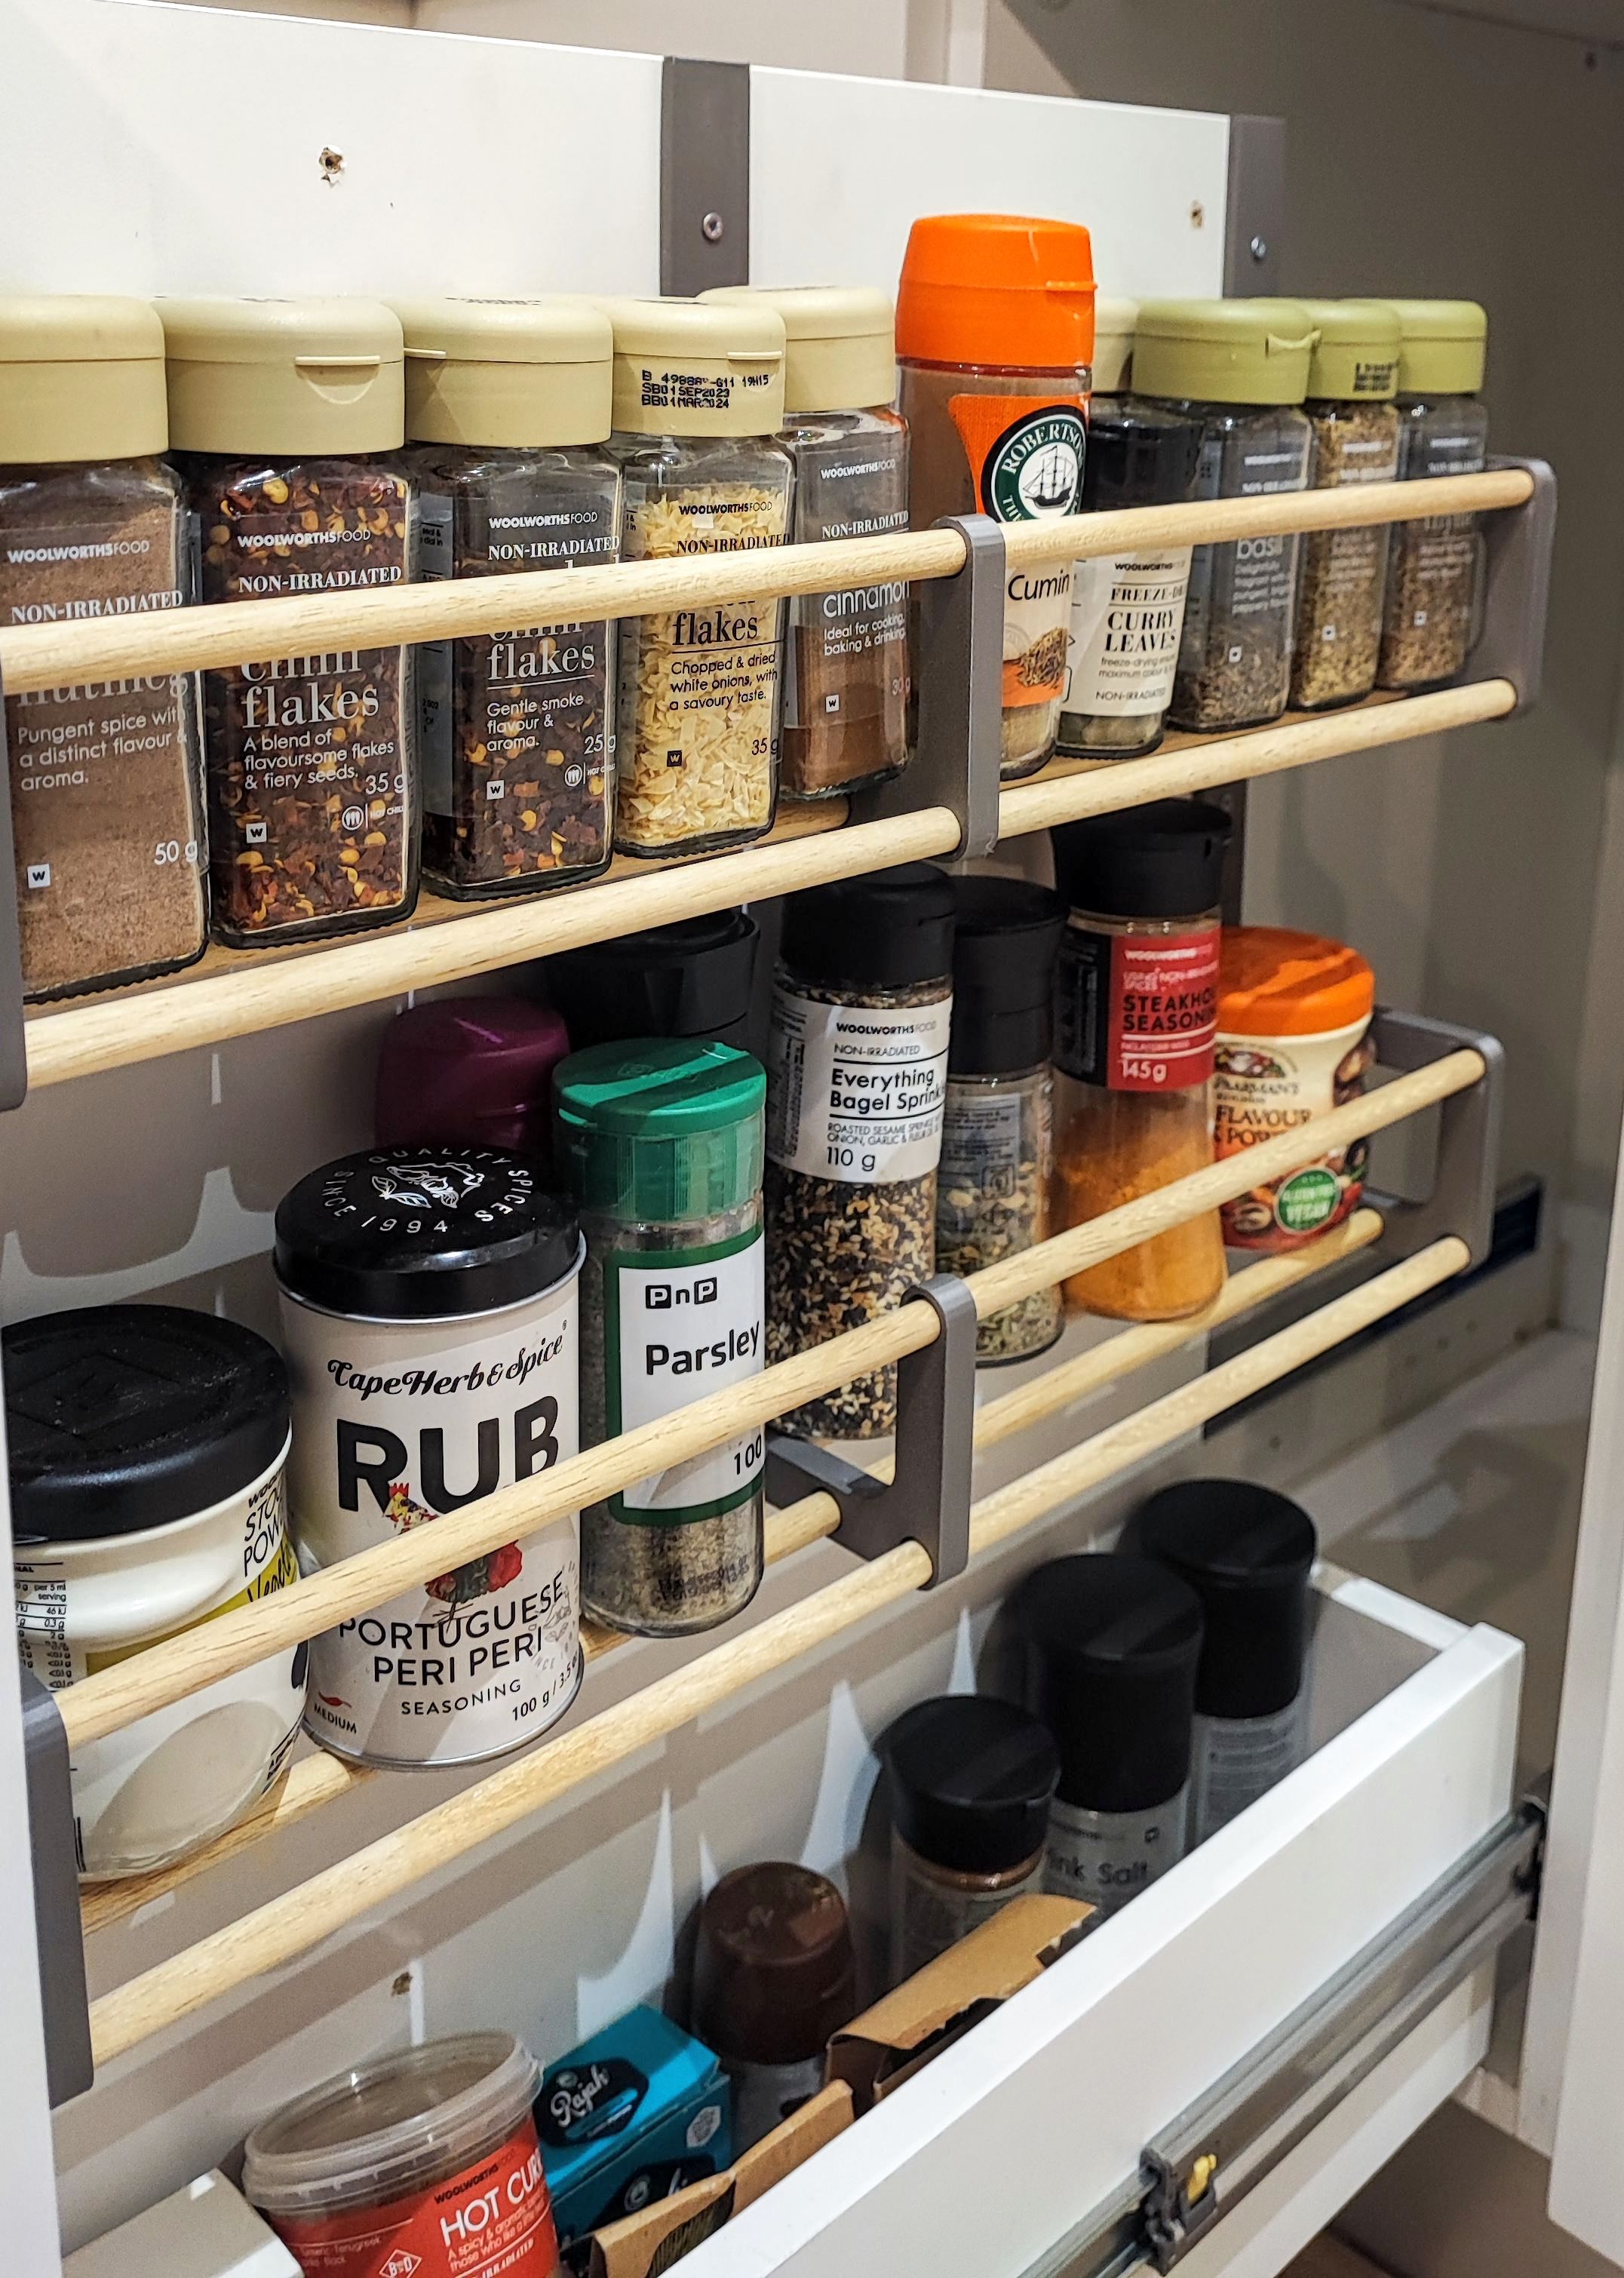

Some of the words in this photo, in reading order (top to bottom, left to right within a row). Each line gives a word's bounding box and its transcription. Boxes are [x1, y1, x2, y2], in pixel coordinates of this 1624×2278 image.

[822, 510, 909, 539] NON-IRRADIATED
[488, 535, 619, 560] NON-IRRADIATED
[677, 533, 790, 554] NON-IRRADIATED
[238, 566, 402, 594] NON-IRRADIATED
[1008, 569, 1070, 601] Cumin
[12, 590, 183, 624] NON-IRRADIATED
[1108, 607, 1176, 631] CURRY
[671, 610, 758, 646] flakes
[855, 622, 870, 635] for
[824, 638, 862, 656] baking
[864, 635, 873, 649] &
[487, 642, 595, 681] flakes
[671, 657, 732, 675] Chopped
[735, 655, 744, 668] &
[748, 650, 775, 667] dried
[671, 677, 708, 693] white
[711, 674, 752, 689] onions,
[757, 669, 778, 683] with
[241, 682, 379, 729] flakes
[487, 698, 537, 717] Gentle
[542, 692, 584, 711] smoke
[669, 701, 679, 711] a
[683, 694, 733, 711] savoury
[738, 689, 766, 704] taste.
[18, 719, 94, 744] Pungent
[101, 714, 146, 737] spice
[487, 717, 539, 735] flavour
[543, 714, 554, 728] &
[20, 754, 32, 768] a
[40, 741, 106, 766] distinct
[115, 732, 172, 755] flavour
[244, 737, 256, 753] A
[262, 731, 311, 751] blend
[315, 728, 333, 745] of
[487, 735, 540, 752] aroma.
[584, 734, 603, 755] 25
[752, 738, 767, 756] 35
[770, 738, 778, 755] g
[244, 748, 347, 772] flavoursome
[352, 741, 394, 760] flakes
[21, 769, 89, 791] aroma.
[244, 775, 257, 791] &
[263, 772, 303, 790] fiery
[307, 764, 358, 784] seeds.
[365, 772, 388, 795] 35
[154, 840, 180, 866] 50
[185, 840, 198, 863] g
[833, 1043, 921, 1057] NON-IRRADIATED
[831, 1068, 935, 1093] Everything
[830, 1091, 890, 1114] Bagel
[826, 1146, 853, 1166] 110
[861, 1153, 876, 1172] g
[368, 1147, 513, 1166] QUALITY
[474, 1169, 534, 1223] SPICES
[321, 1170, 357, 1217] SINCE
[361, 1214, 449, 1234] 1994
[646, 1320, 760, 1377] Parsley
[337, 1395, 559, 1515] RUB
[38, 1592, 66, 1602] serving
[339, 1570, 563, 1650] PORTUGUESE
[374, 1656, 456, 1686] PERI
[469, 1626, 542, 1677] PERI
[401, 1679, 522, 1715] SEASONING
[511, 1696, 537, 1721] 100
[542, 1689, 551, 1708] g
[314, 1703, 358, 1734] MEDIUM
[440, 2186, 500, 2247] HOT
[448, 2248, 457, 2262] A
[459, 2235, 485, 2258] spicy
[480, 2239, 502, 2257] who
